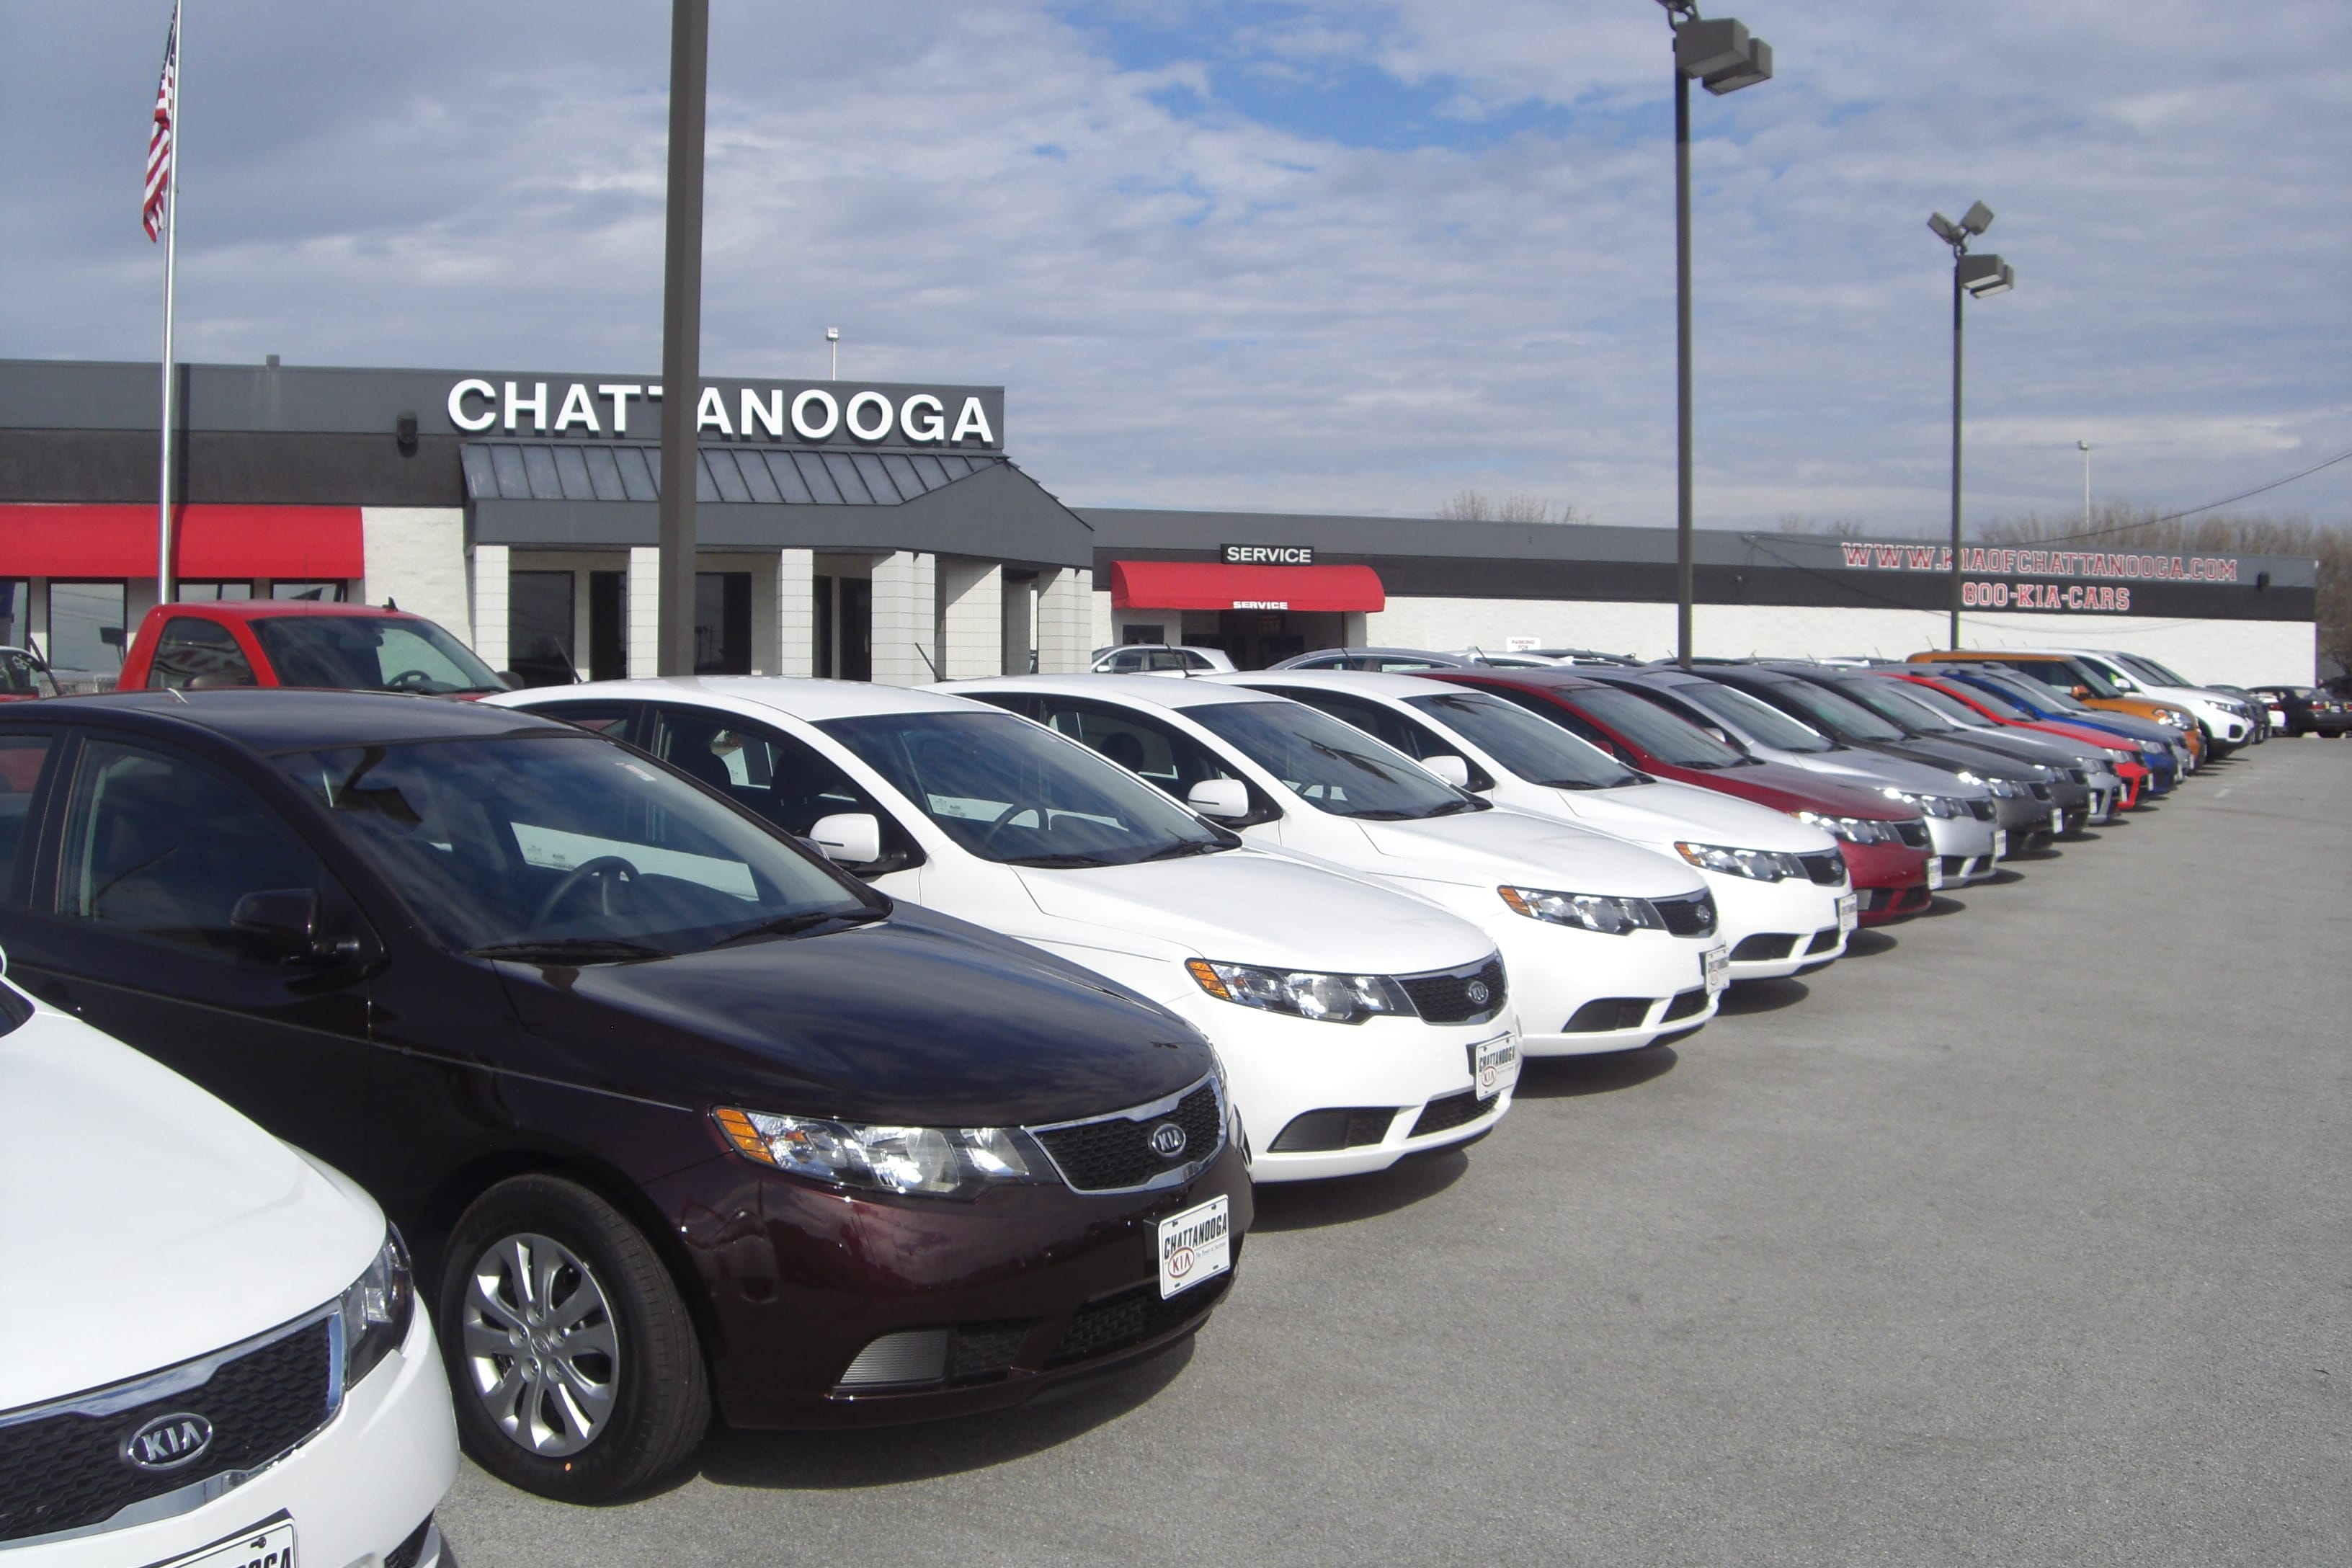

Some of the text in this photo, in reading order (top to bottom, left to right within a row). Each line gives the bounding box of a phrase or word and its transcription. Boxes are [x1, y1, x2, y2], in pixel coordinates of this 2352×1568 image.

[1226, 545, 1312, 564] SERVICE
[1233, 600, 1288, 610] SERVICE
[1962, 582, 2131, 611] 800-KIA-CARS
[1483, 1070, 1495, 1083] KIA
[1157, 1129, 1182, 1152] KIA
[1164, 1212, 1227, 1260] CHATTANOOGA
[1172, 1252, 1192, 1274] KIA
[141, 1420, 203, 1462] KIA
